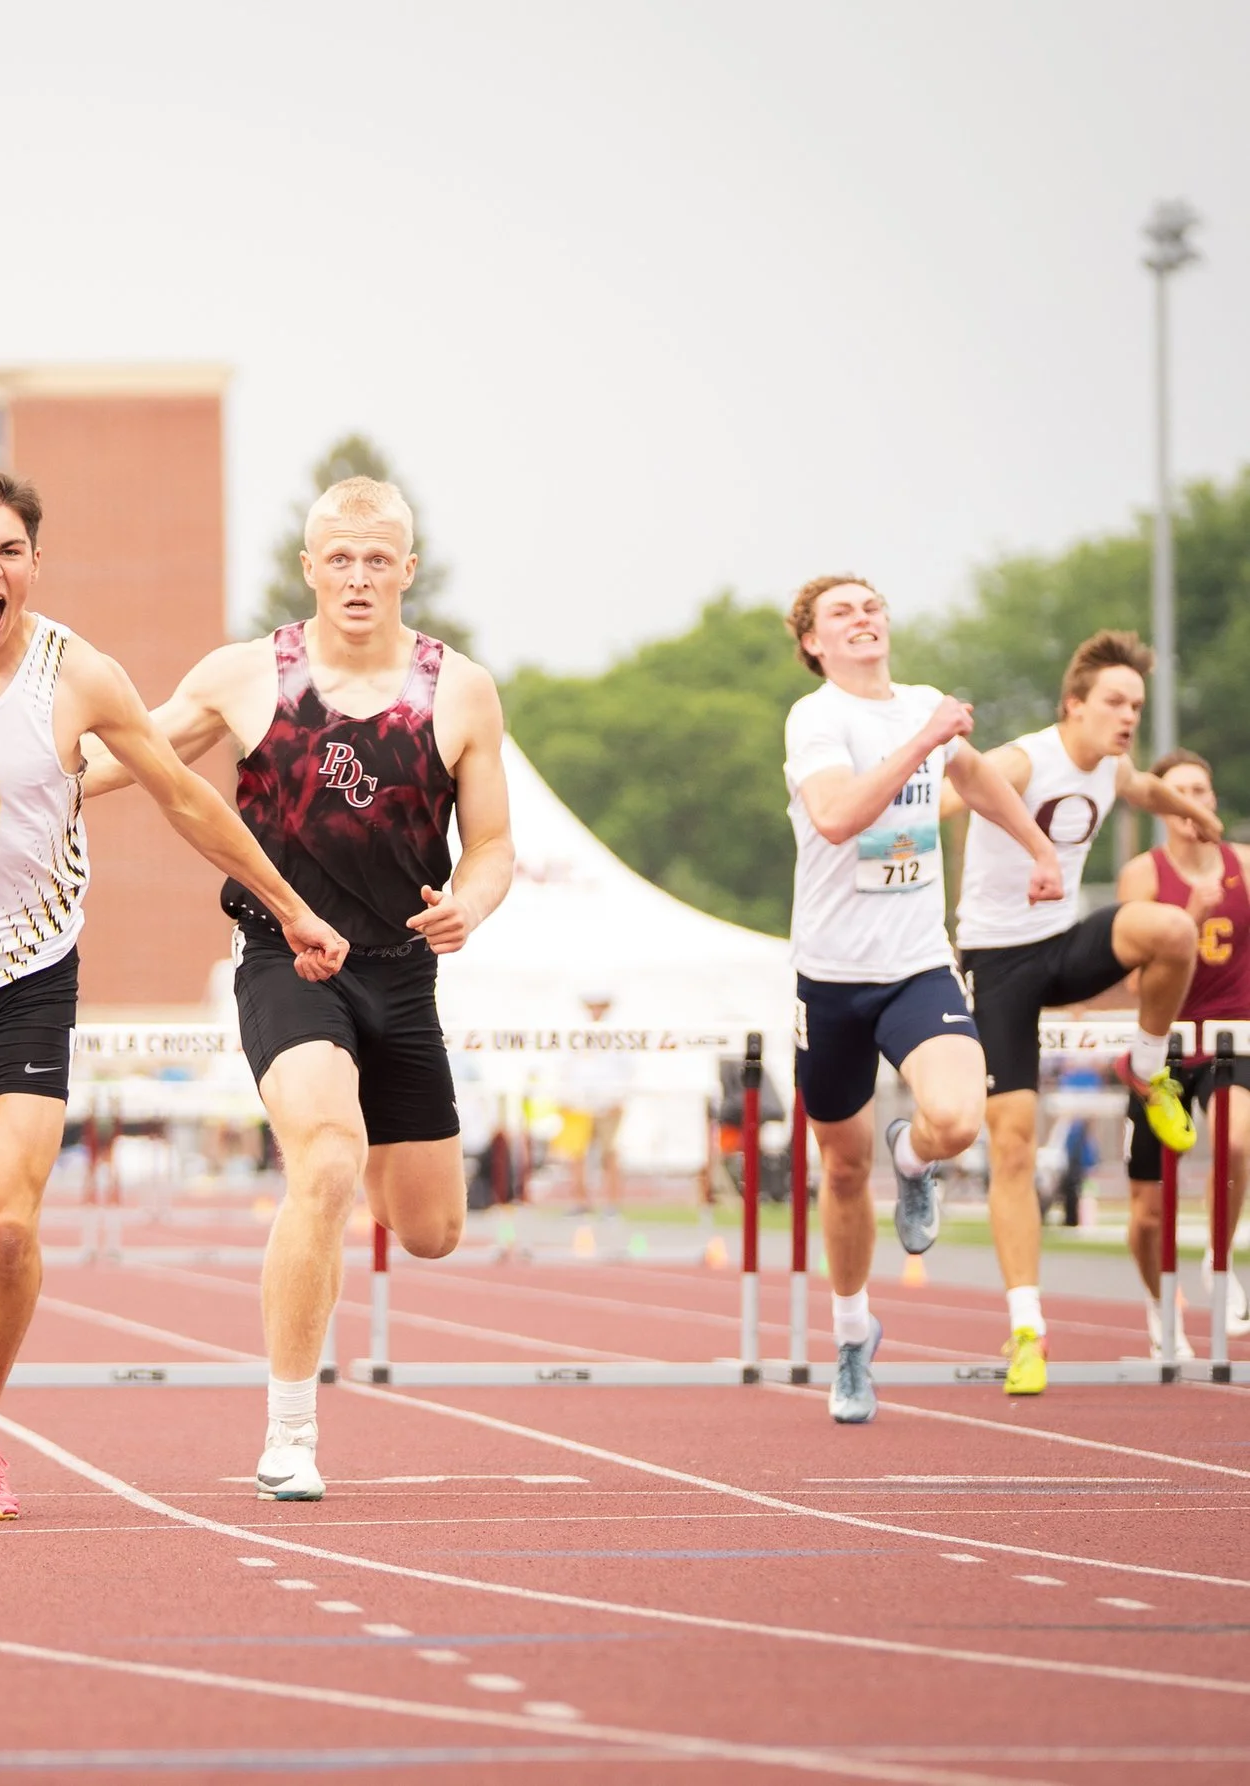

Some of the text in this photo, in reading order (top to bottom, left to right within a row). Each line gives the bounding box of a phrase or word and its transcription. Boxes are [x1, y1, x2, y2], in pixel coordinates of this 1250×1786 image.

[318, 742, 378, 808] PDC
[882, 861, 919, 885] 712
[568, 1029, 650, 1051] CROSSE
